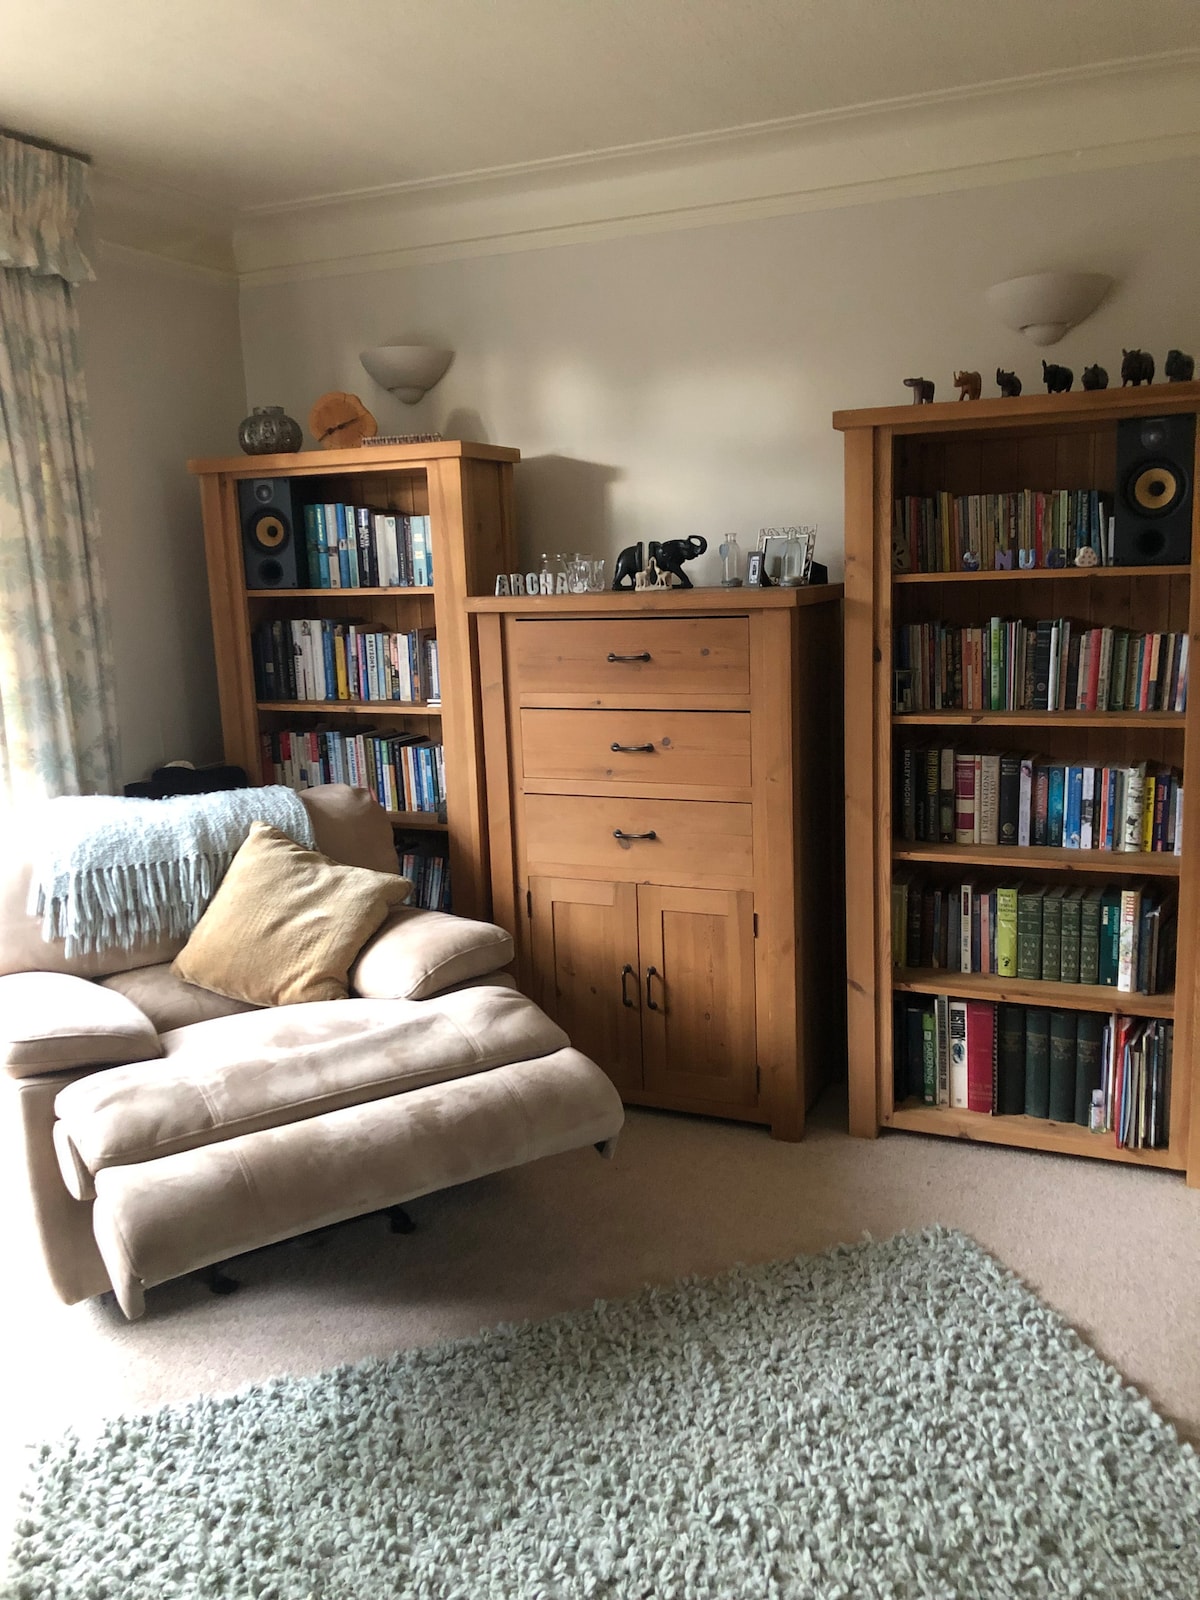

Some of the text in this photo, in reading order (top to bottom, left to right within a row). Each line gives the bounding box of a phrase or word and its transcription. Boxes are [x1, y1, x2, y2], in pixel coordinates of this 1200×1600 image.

[989, 780, 997, 813] OXFORD
[1126, 895, 1135, 925] BIBLE
[951, 1009, 966, 1041] HISTORY
[925, 1041, 933, 1085] GARDENING
